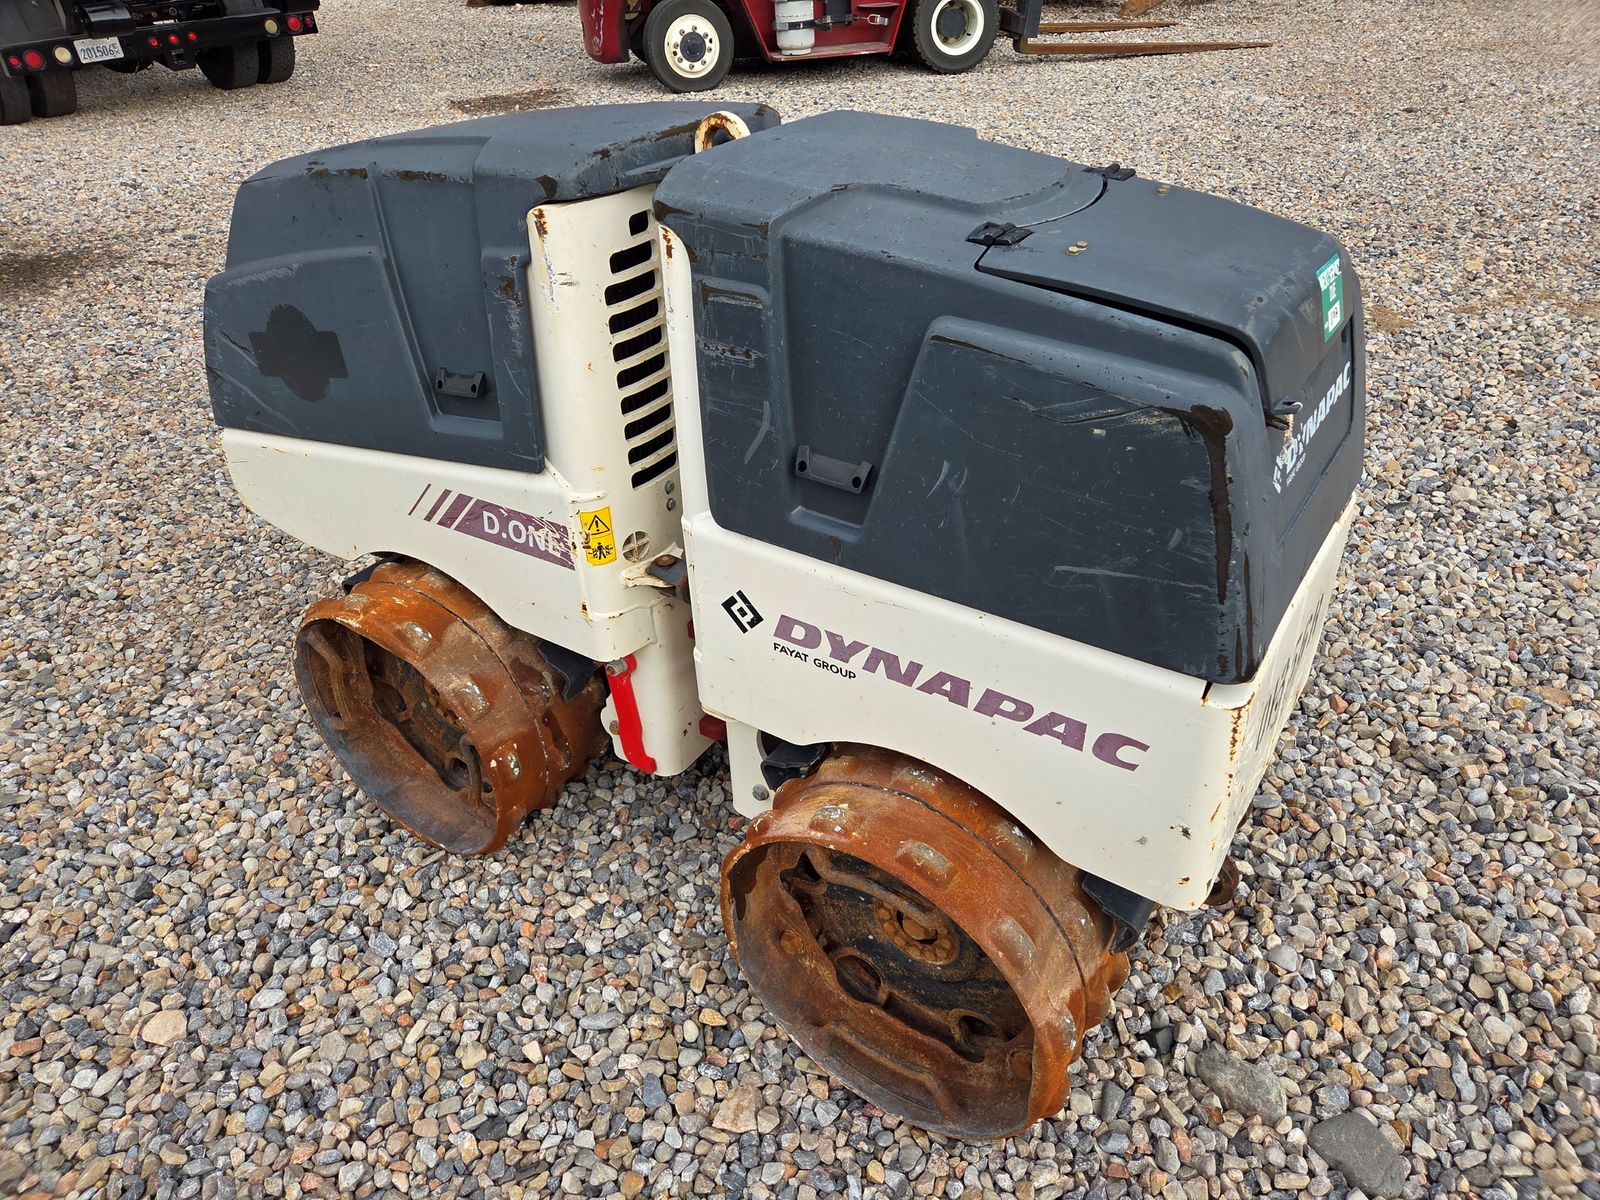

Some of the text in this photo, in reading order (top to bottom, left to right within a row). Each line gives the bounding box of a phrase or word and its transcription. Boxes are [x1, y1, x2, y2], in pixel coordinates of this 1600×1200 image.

[80, 44, 114, 60] 201506
[1285, 360, 1352, 475] DYNAPAC
[773, 642, 857, 680] FAYAT GROUP
[773, 614, 1150, 772] DYNAPAC
